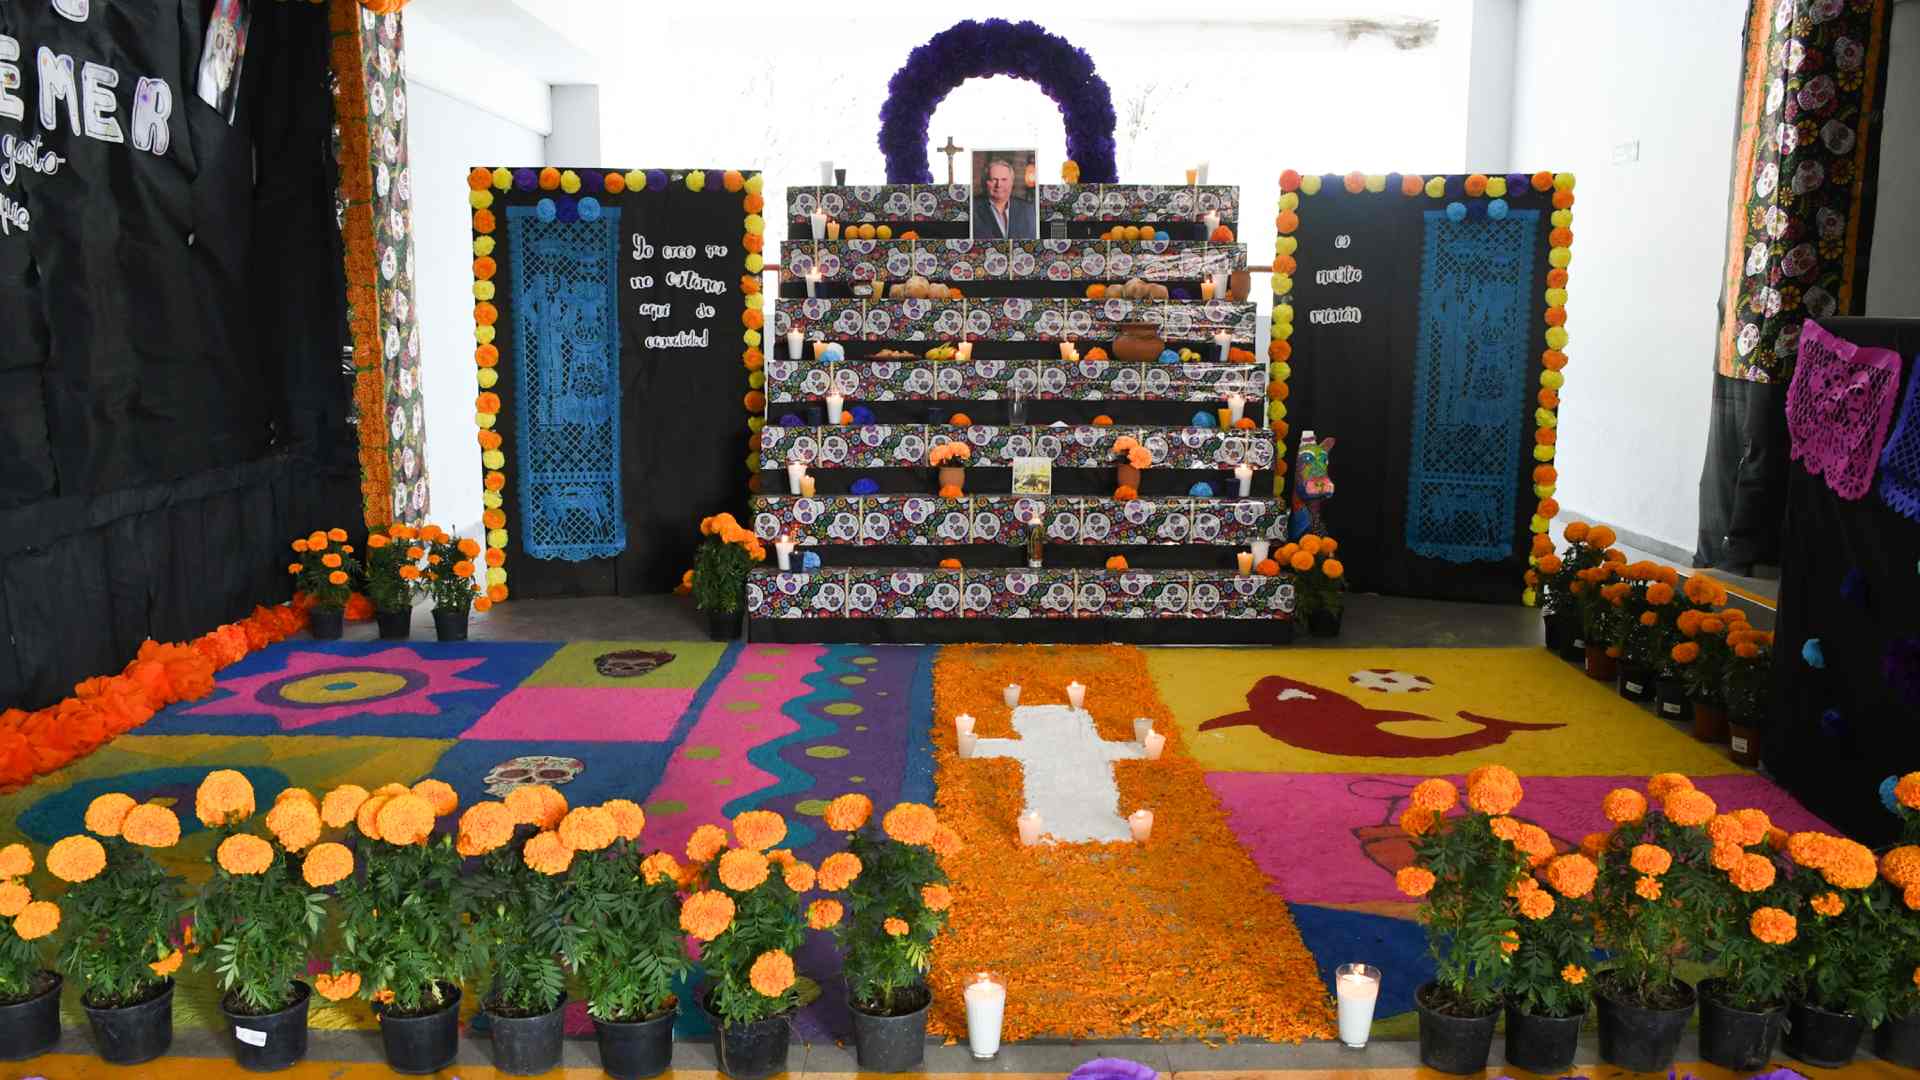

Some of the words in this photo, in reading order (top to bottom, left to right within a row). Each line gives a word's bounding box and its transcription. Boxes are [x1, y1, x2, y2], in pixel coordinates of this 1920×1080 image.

[632, 233, 654, 260] Yo
[662, 245, 696, 259] creo
[705, 244, 728, 258] que
[630, 276, 654, 289] no
[665, 270, 727, 295] estamos
[696, 303, 716, 318] de
[645, 328, 709, 349] casualidad
